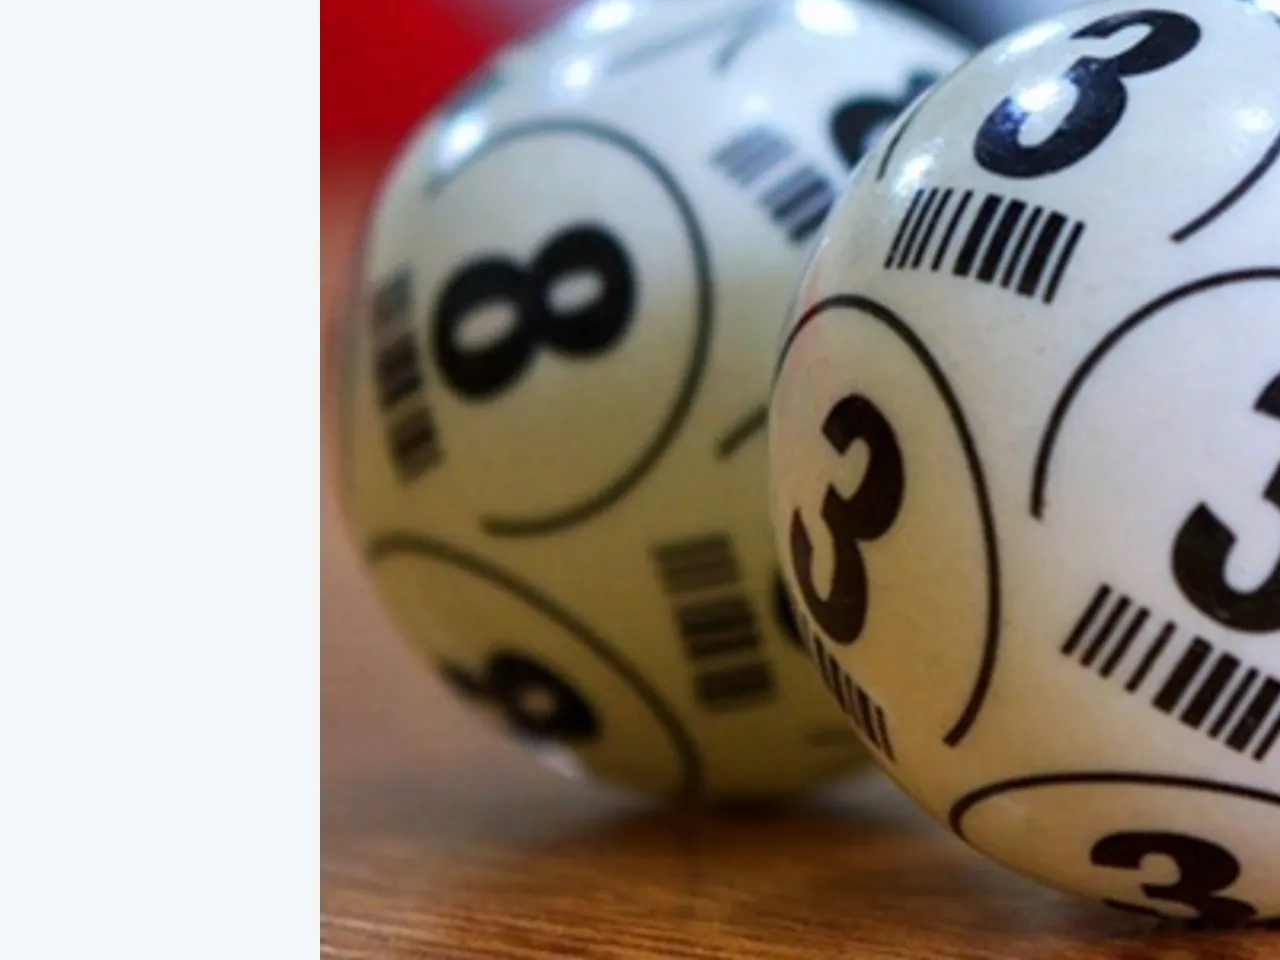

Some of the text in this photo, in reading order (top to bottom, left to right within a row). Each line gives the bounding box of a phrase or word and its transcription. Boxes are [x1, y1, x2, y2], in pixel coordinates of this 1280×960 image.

[973, 8, 1201, 179] 3
[432, 222, 638, 404] 8
[790, 393, 906, 646] 3
[1089, 830, 1258, 929] 3
